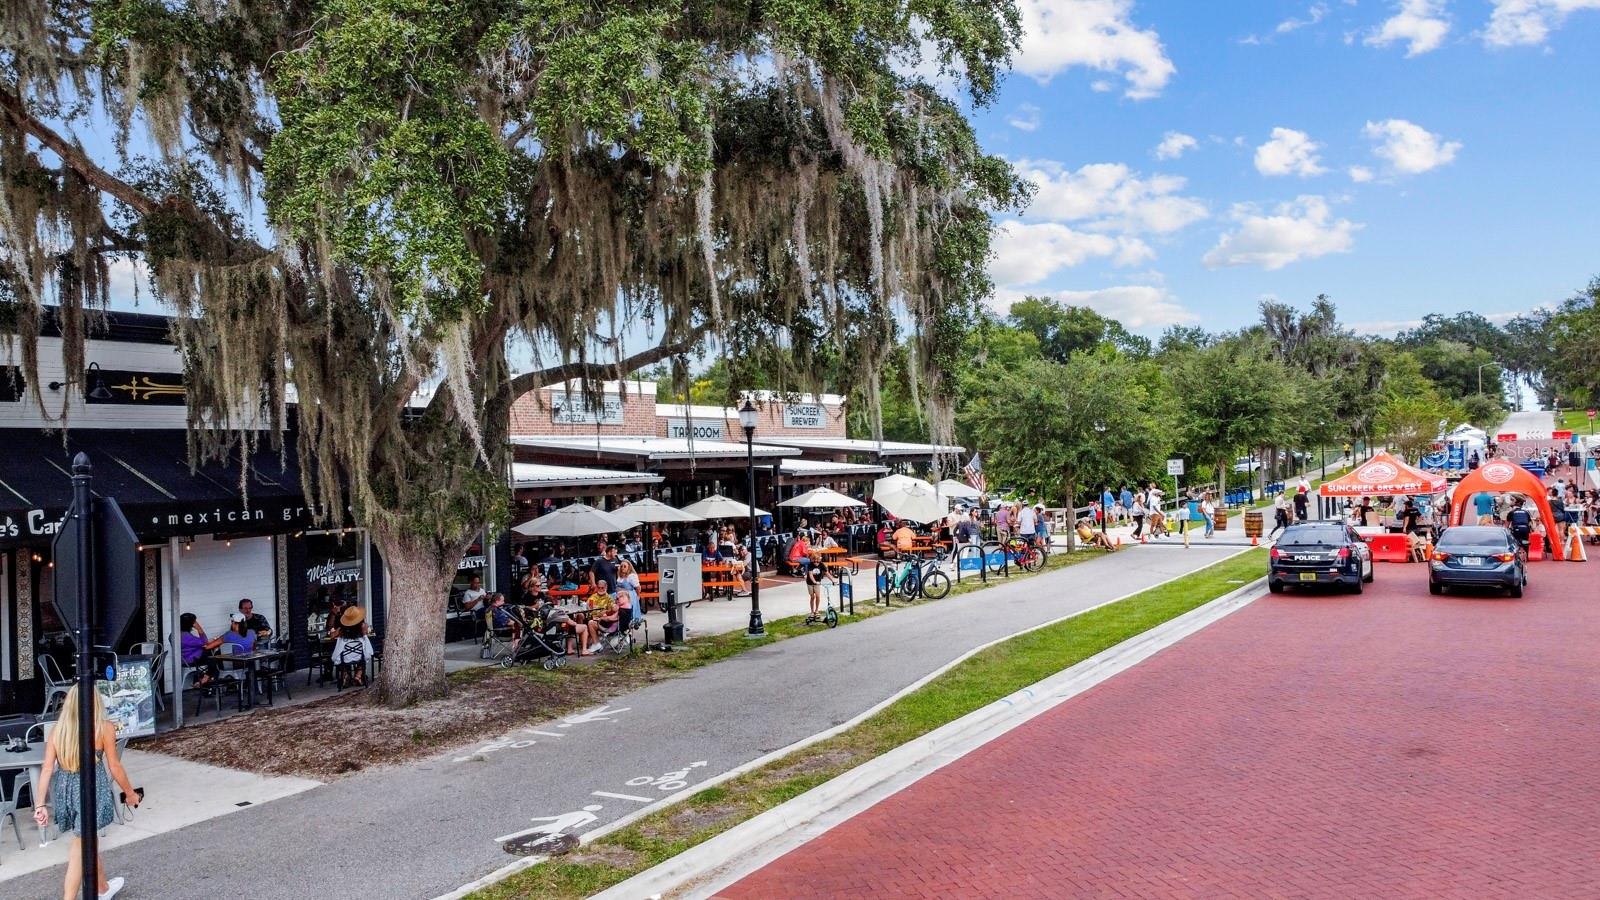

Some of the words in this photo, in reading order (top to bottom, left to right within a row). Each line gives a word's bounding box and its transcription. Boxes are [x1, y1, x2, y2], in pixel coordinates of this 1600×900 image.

[791, 417, 819, 426] BREWERY
[1327, 484, 1375, 492] SUNCREEK
[168, 508, 264, 525] mexican
[320, 573, 360, 585] REALTY
